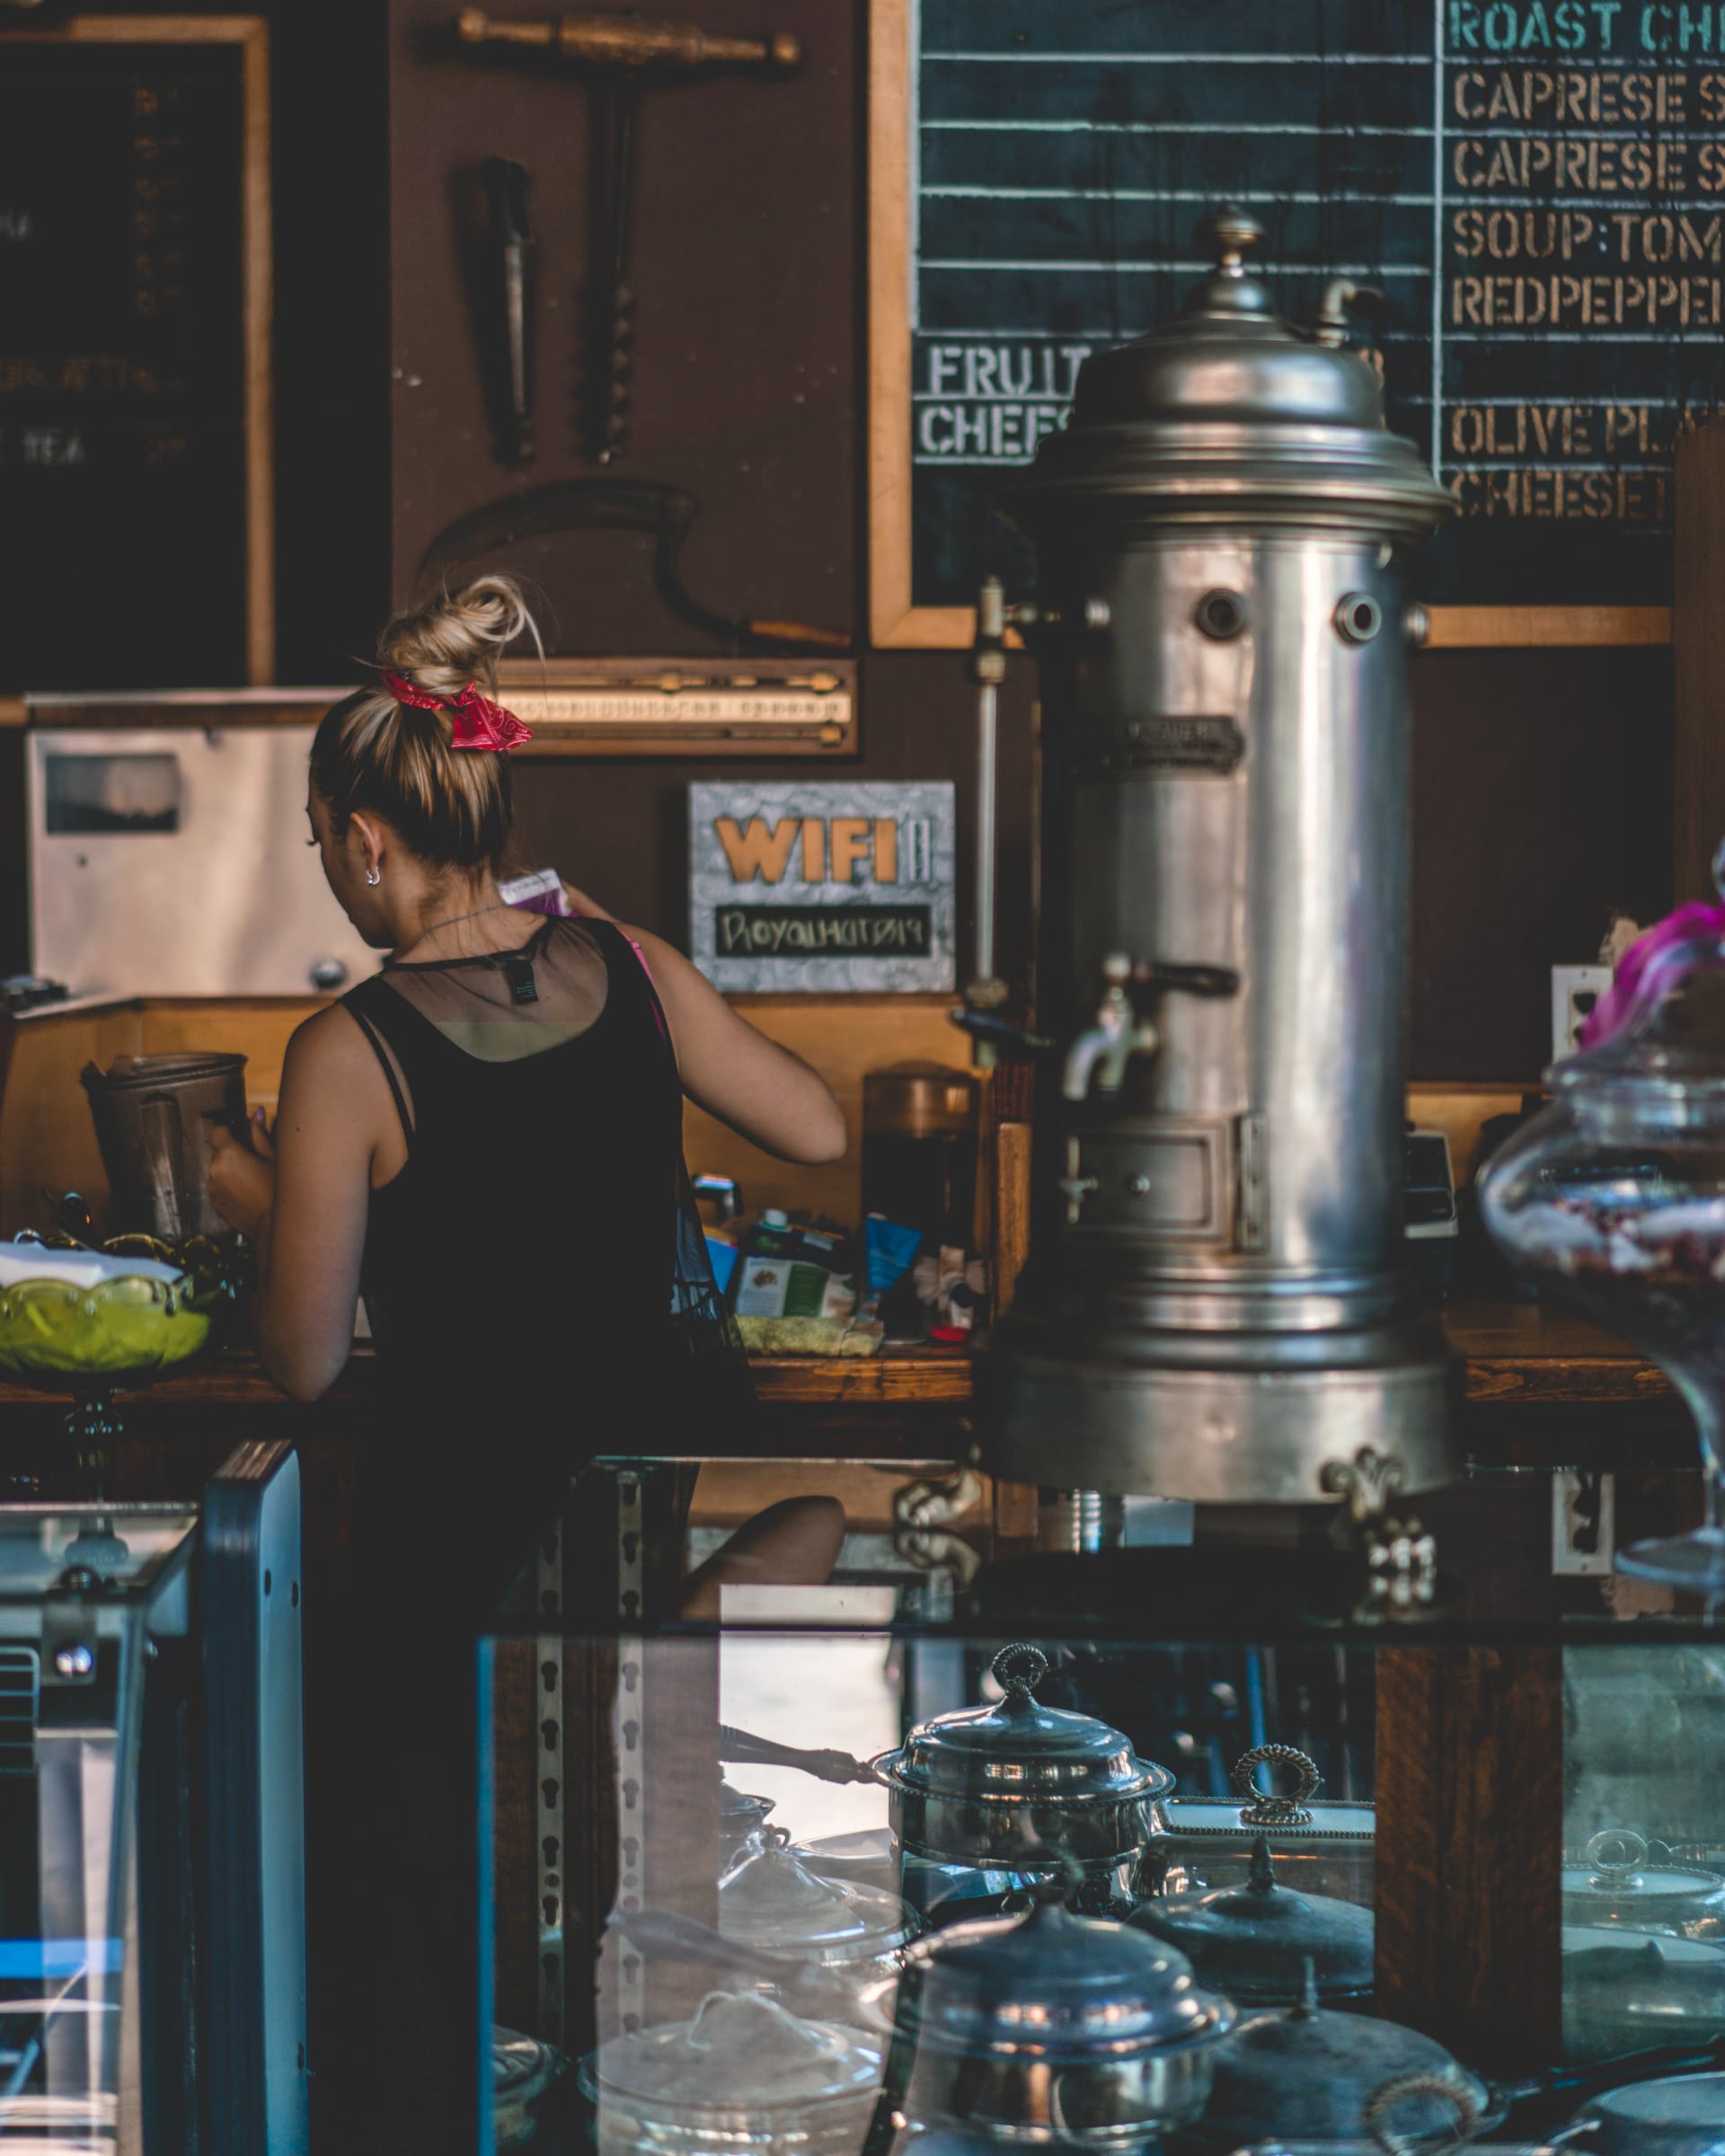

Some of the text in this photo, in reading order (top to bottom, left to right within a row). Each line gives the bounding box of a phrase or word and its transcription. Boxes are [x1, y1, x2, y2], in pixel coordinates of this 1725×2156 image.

[1449, 2, 1622, 50] ROAST
[1454, 71, 1686, 122] CAPRESE
[1454, 139, 1687, 191] CAPRESE
[1451, 406, 1592, 454] OLIVE
[714, 817, 897, 882] WIFI
